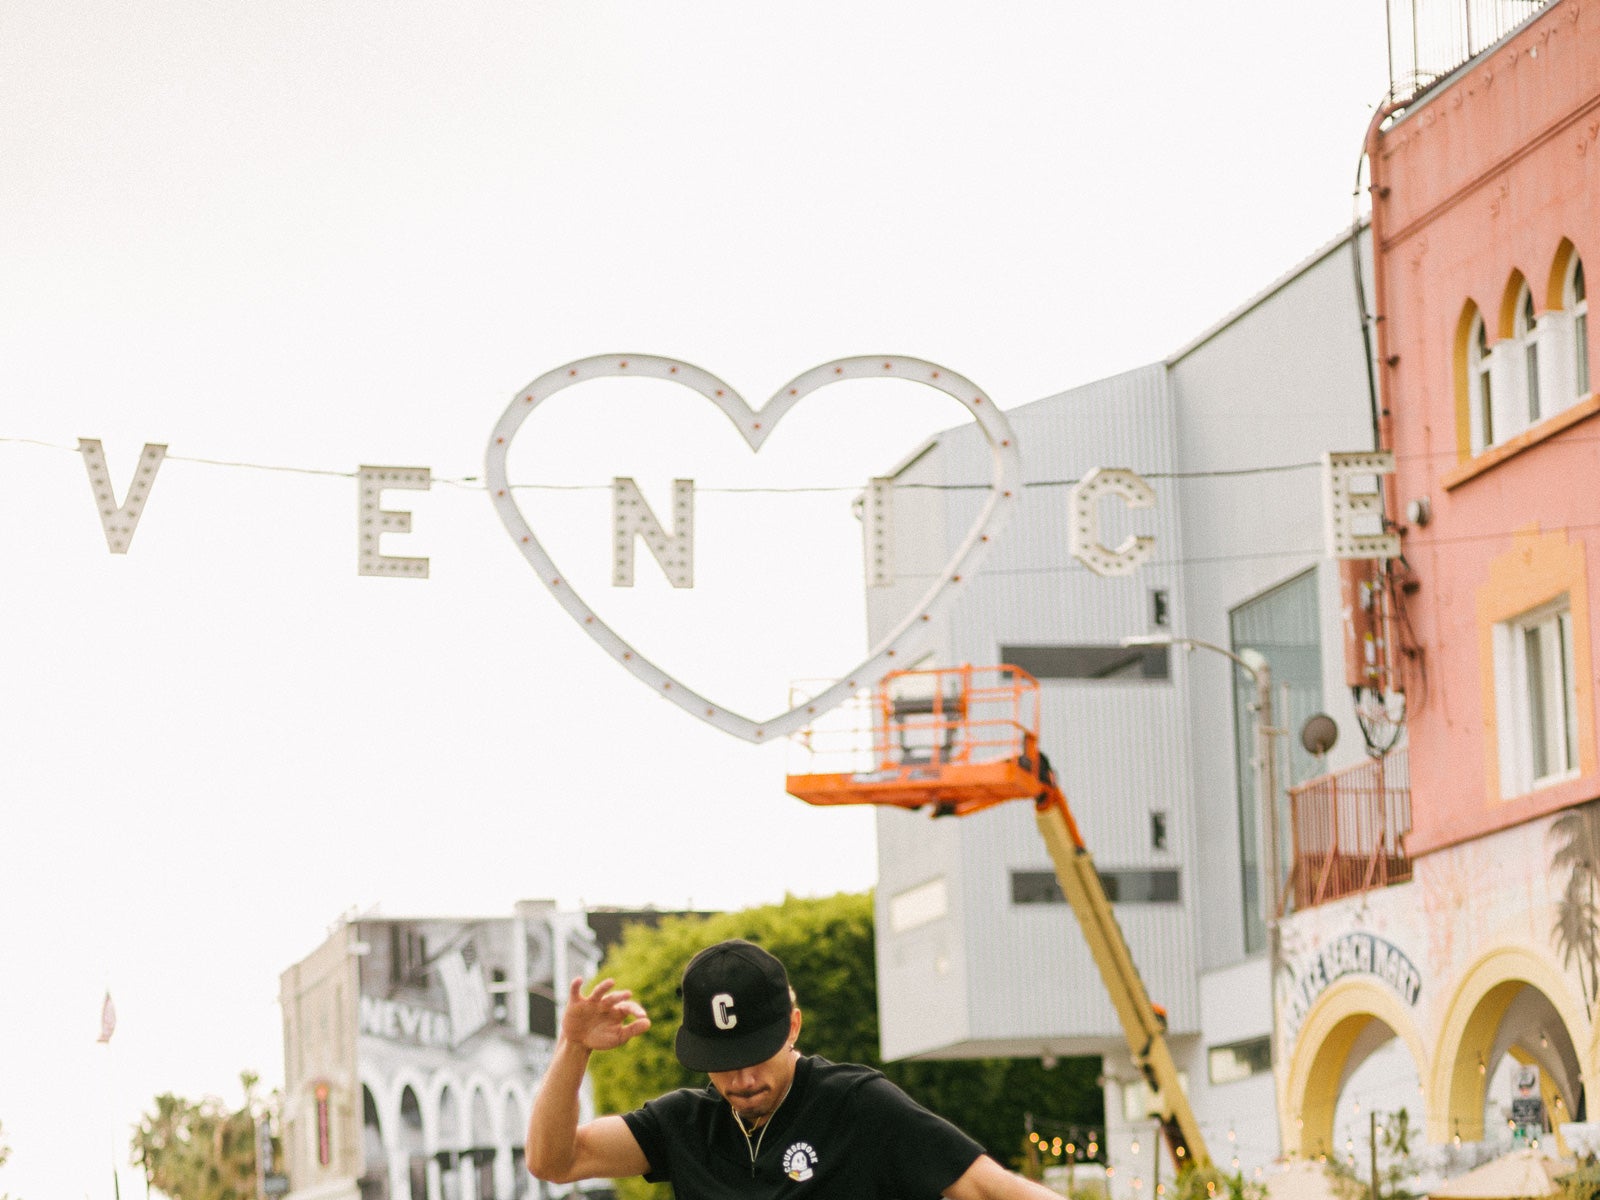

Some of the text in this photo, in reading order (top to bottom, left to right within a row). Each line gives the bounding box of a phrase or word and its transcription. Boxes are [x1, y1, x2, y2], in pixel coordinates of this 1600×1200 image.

[77, 437, 1401, 588] VENICE
[712, 993, 737, 1030] C
[782, 1142, 818, 1173] COURSEWORK
